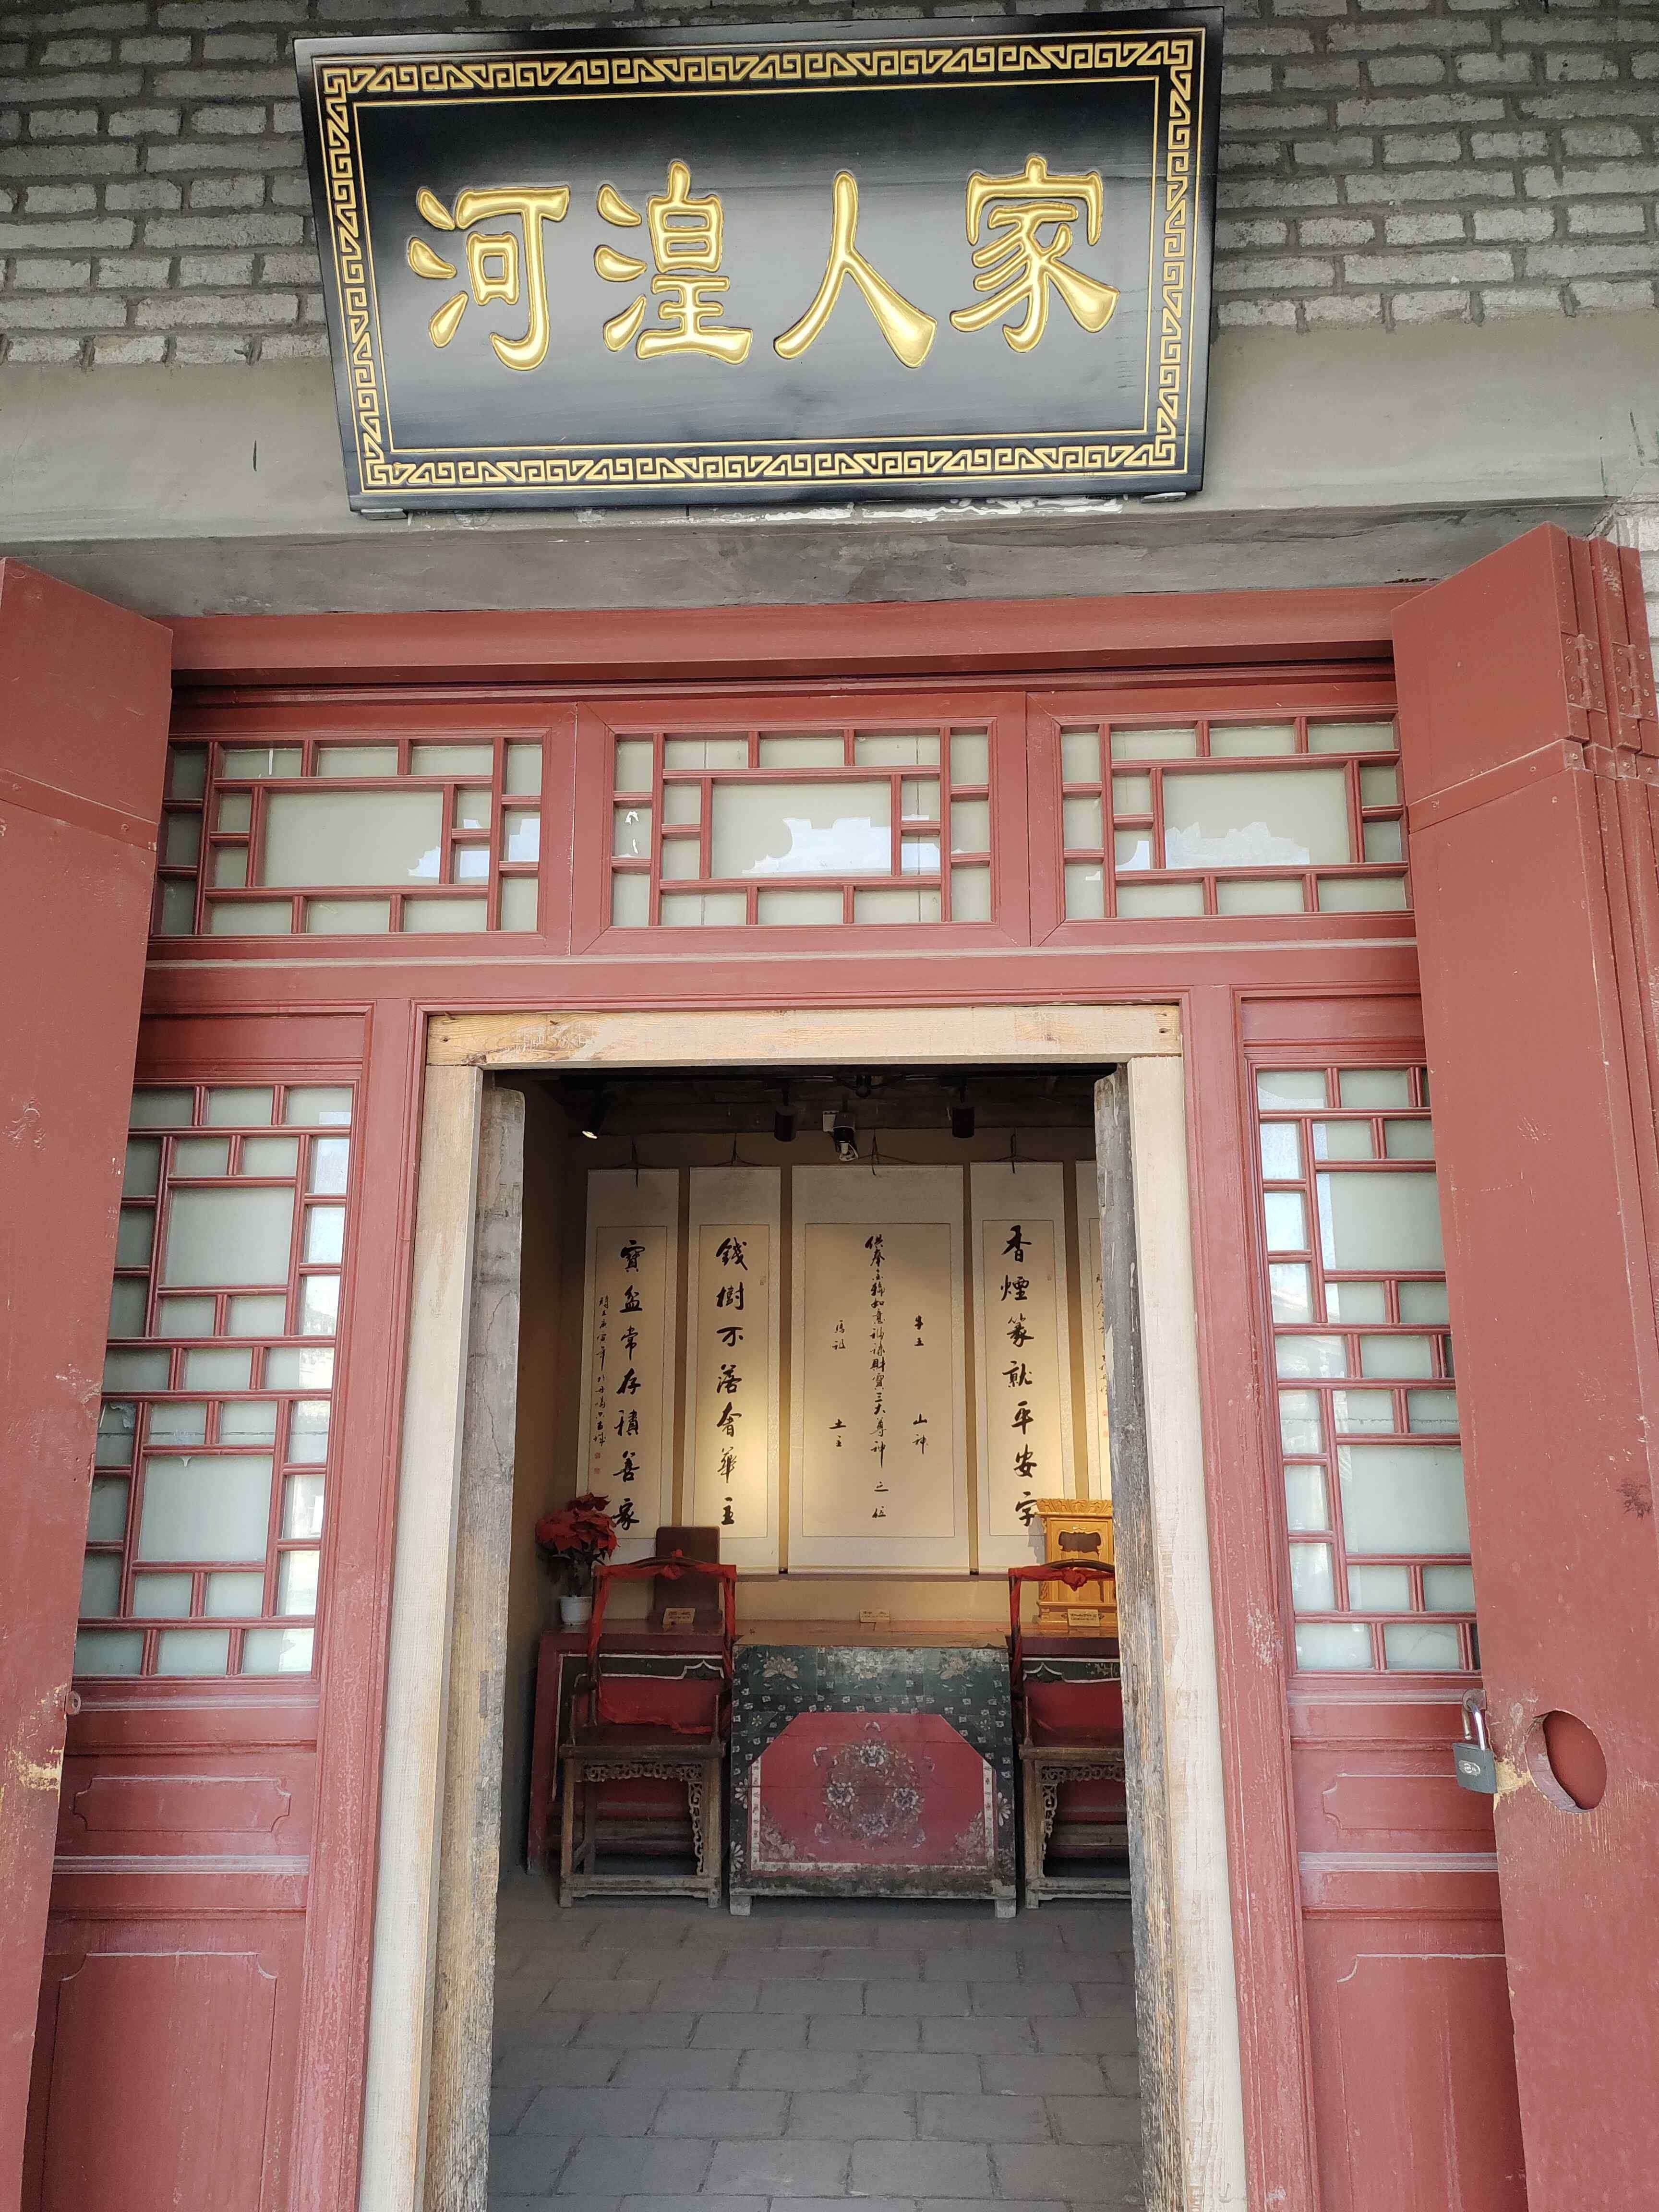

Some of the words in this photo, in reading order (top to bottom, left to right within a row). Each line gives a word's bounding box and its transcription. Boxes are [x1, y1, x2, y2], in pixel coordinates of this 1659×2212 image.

[408, 154, 1119, 371] 河湟人家
[914, 1315, 924, 1346] 牛王
[913, 1414, 928, 1455] 山神
